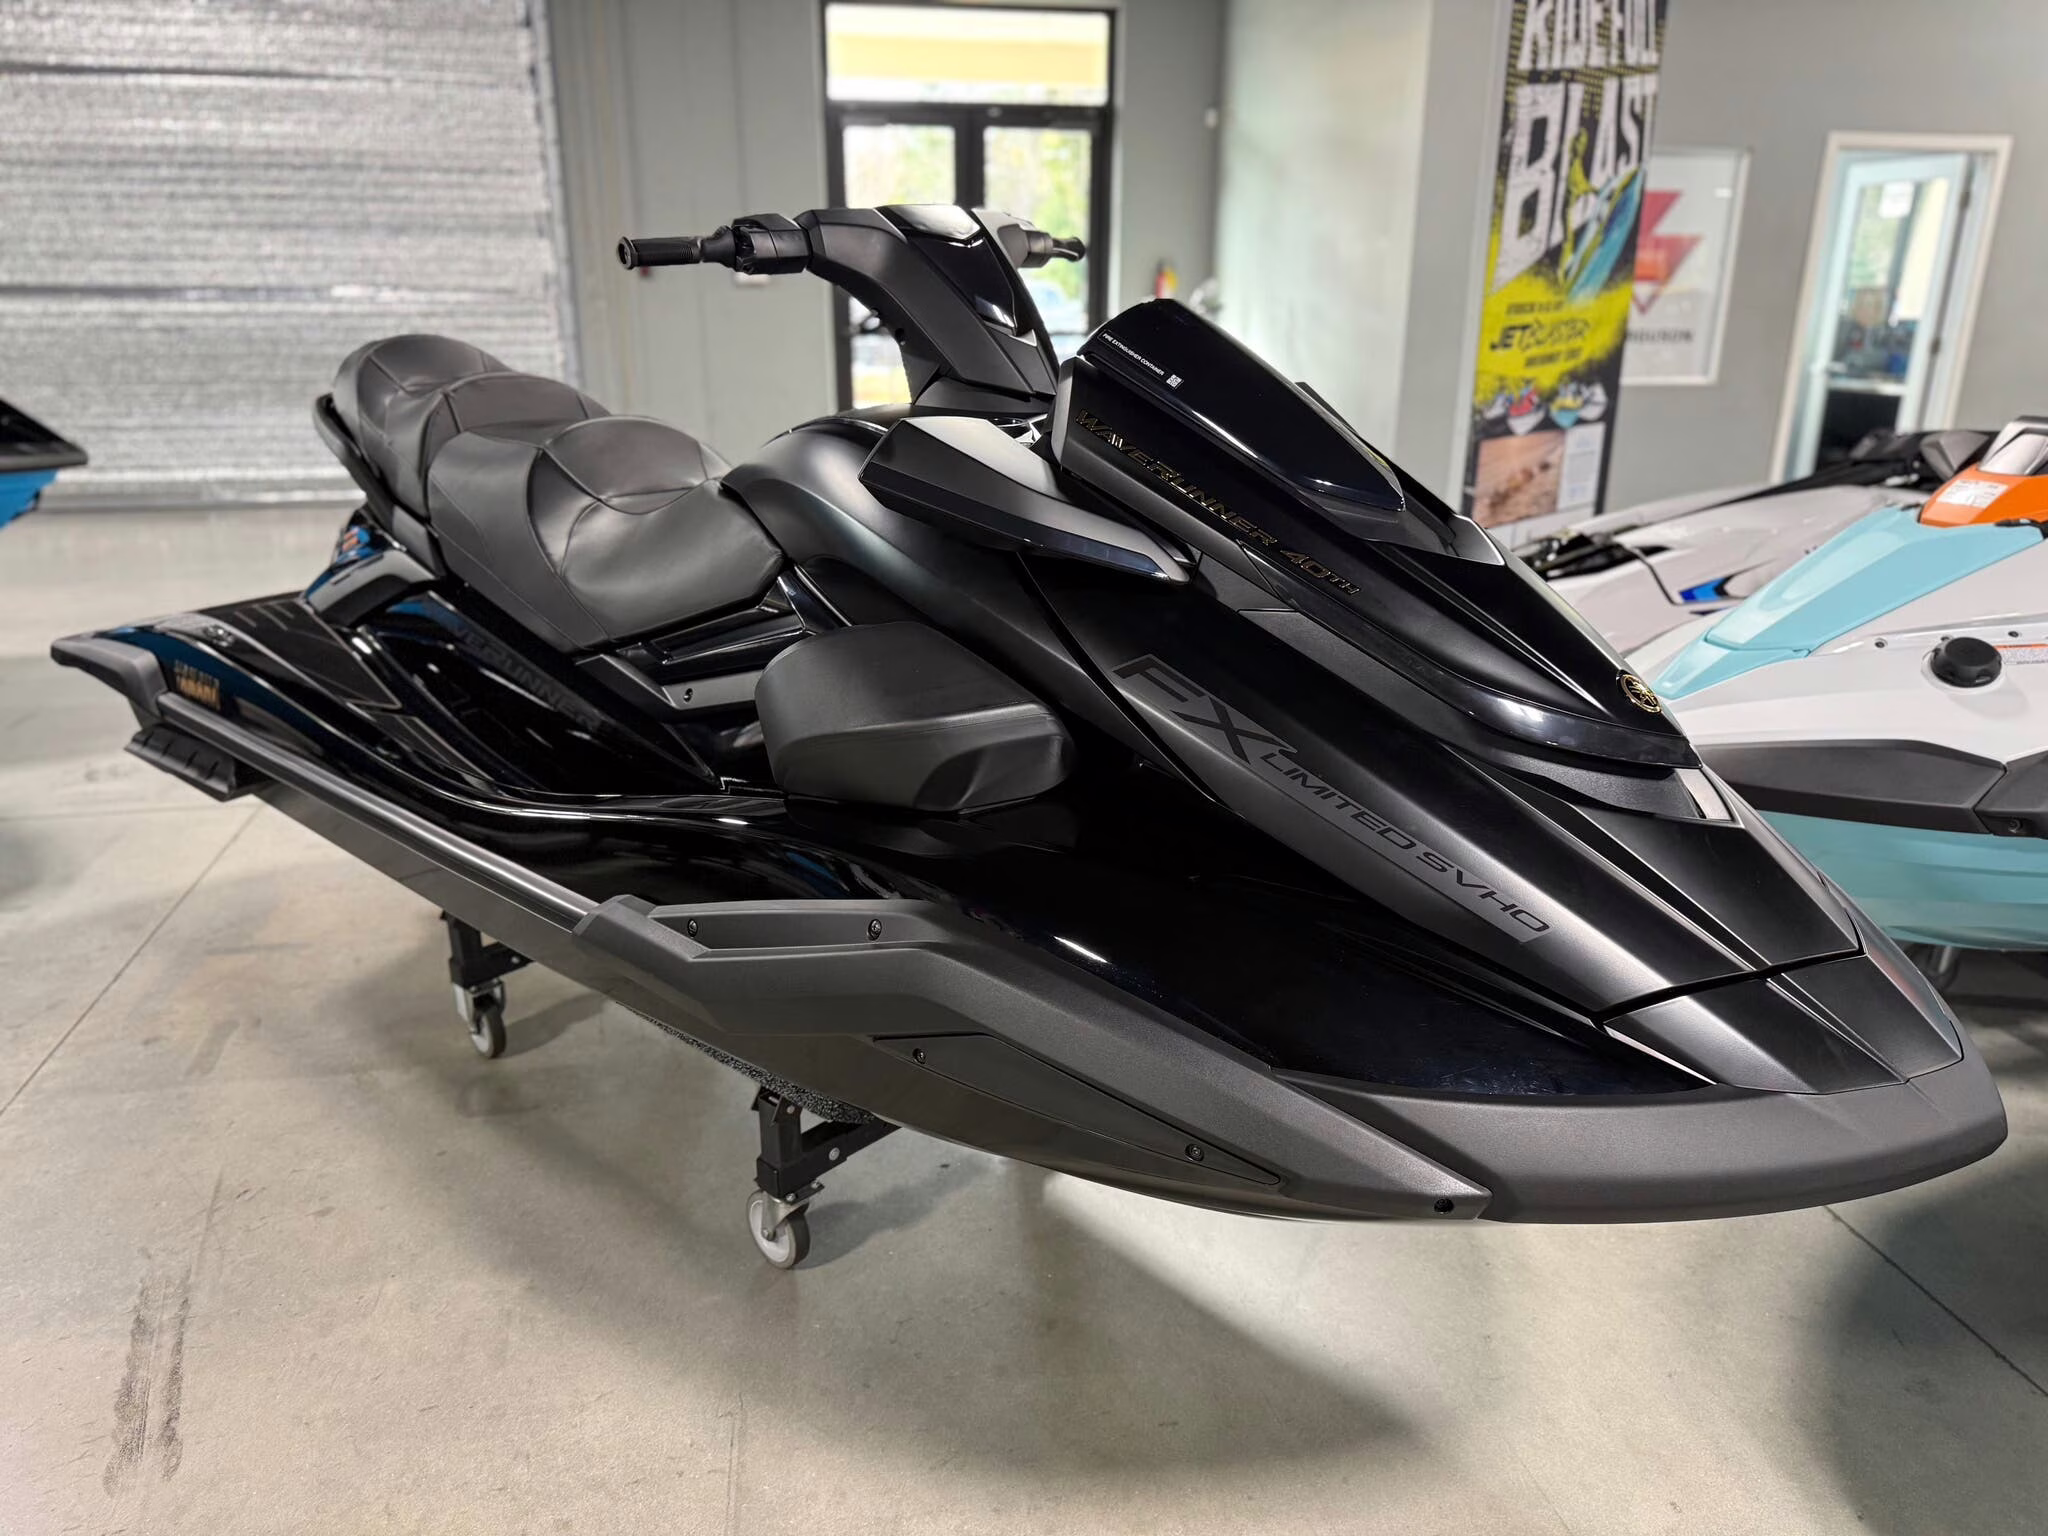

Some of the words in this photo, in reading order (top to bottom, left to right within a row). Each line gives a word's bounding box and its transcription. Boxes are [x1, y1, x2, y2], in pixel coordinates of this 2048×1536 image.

[1492, 73, 1657, 285] BLAST
[1102, 333, 1114, 342] FIRE
[1111, 339, 1142, 361] EXTINGUISHER
[1140, 358, 1165, 376] CONTAINER
[1075, 408, 1278, 546] WAVERUNNER
[1112, 656, 1288, 764] FX
[1260, 750, 1417, 840] LIMITED
[1416, 851, 1550, 932] SVHO
